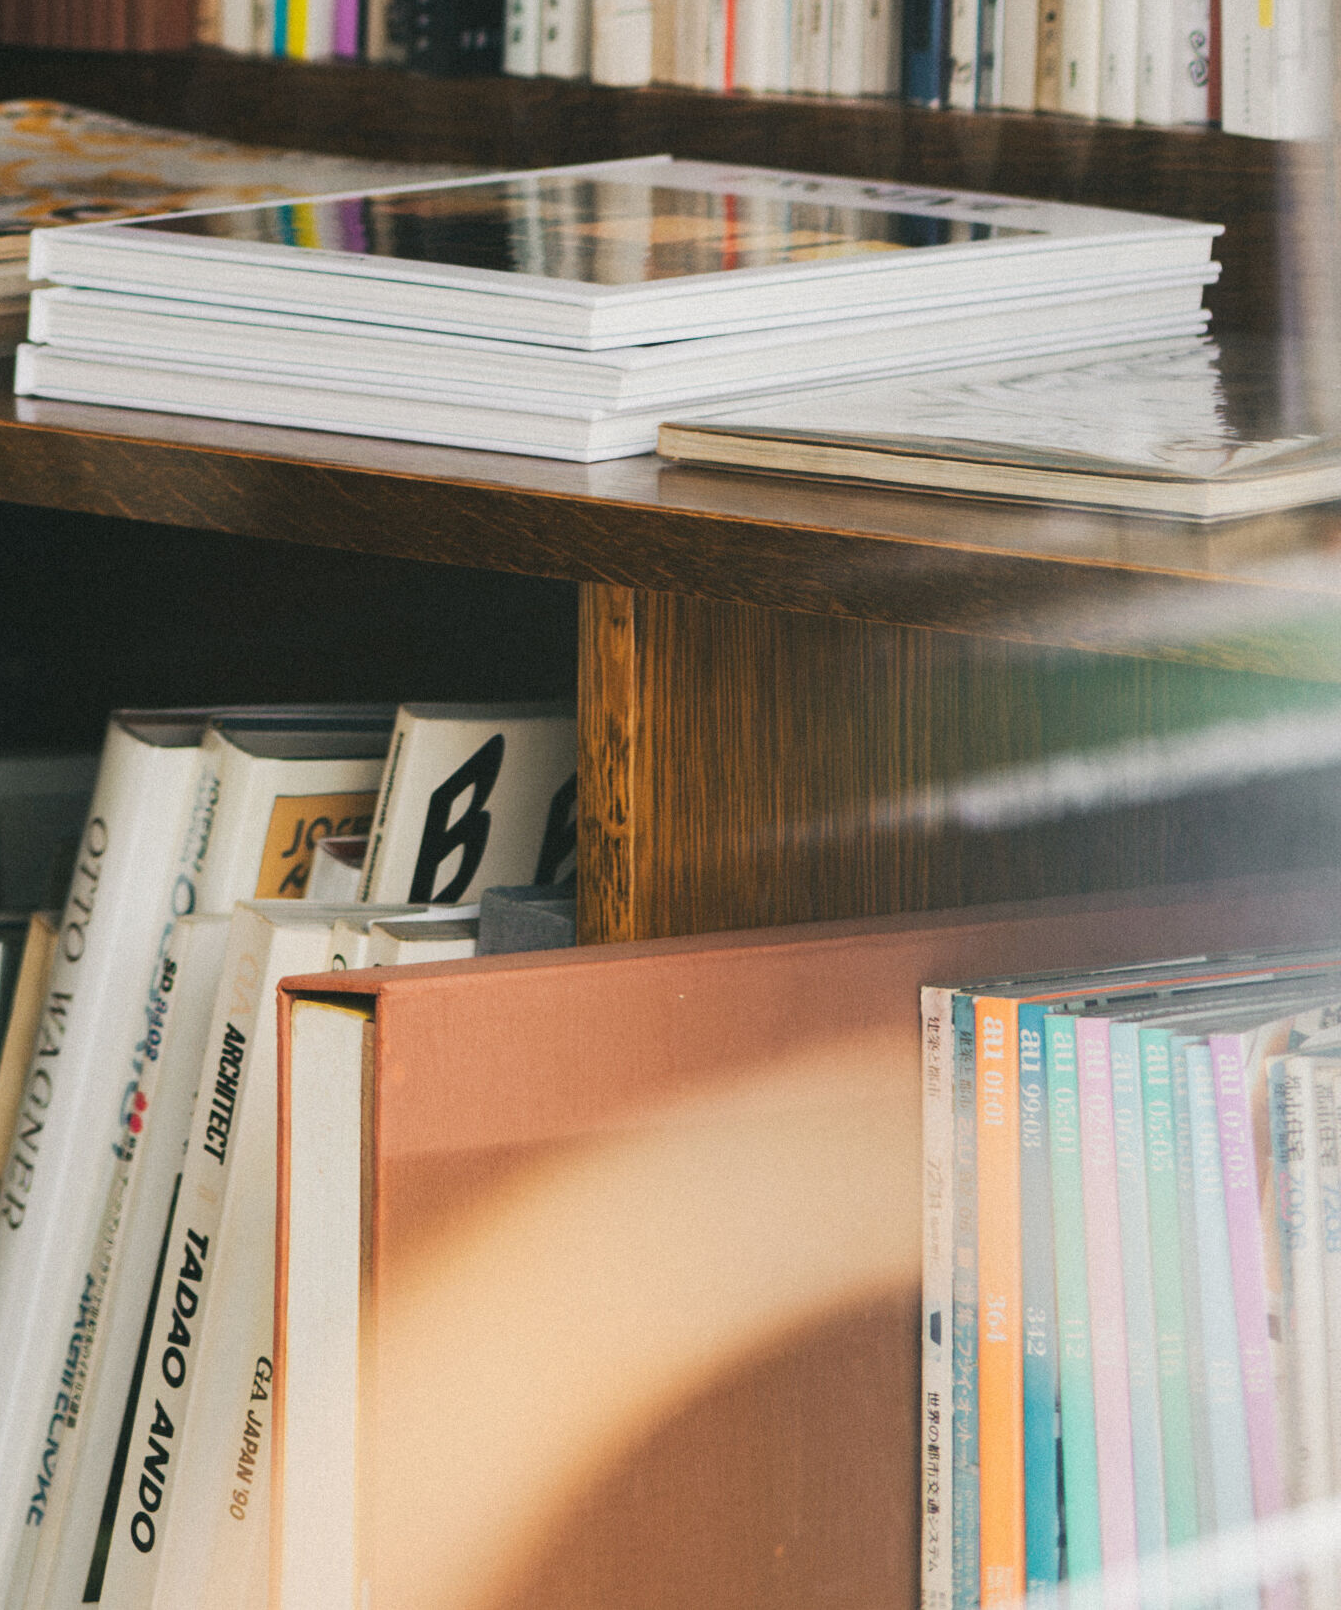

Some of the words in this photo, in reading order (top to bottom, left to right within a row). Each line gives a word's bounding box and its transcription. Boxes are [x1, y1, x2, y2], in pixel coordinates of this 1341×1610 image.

[61, 816, 109, 963] OTTO
[408, 733, 506, 905] B
[2, 990, 73, 1231] WAGNER
[203, 1022, 247, 1165] ARCHITECT
[983, 1070, 1007, 1127] 01:01
[1020, 1083, 1045, 1150] 99:03
[161, 1227, 210, 1389] TADAO
[249, 1354, 274, 1403] GA
[985, 1292, 1007, 1344] 364
[1026, 1306, 1048, 1358] 342
[129, 1398, 176, 1554] ANDO
[234, 1409, 265, 1485] JAPAN
[927, 1391, 942, 1573] 世界の都市交通システム
